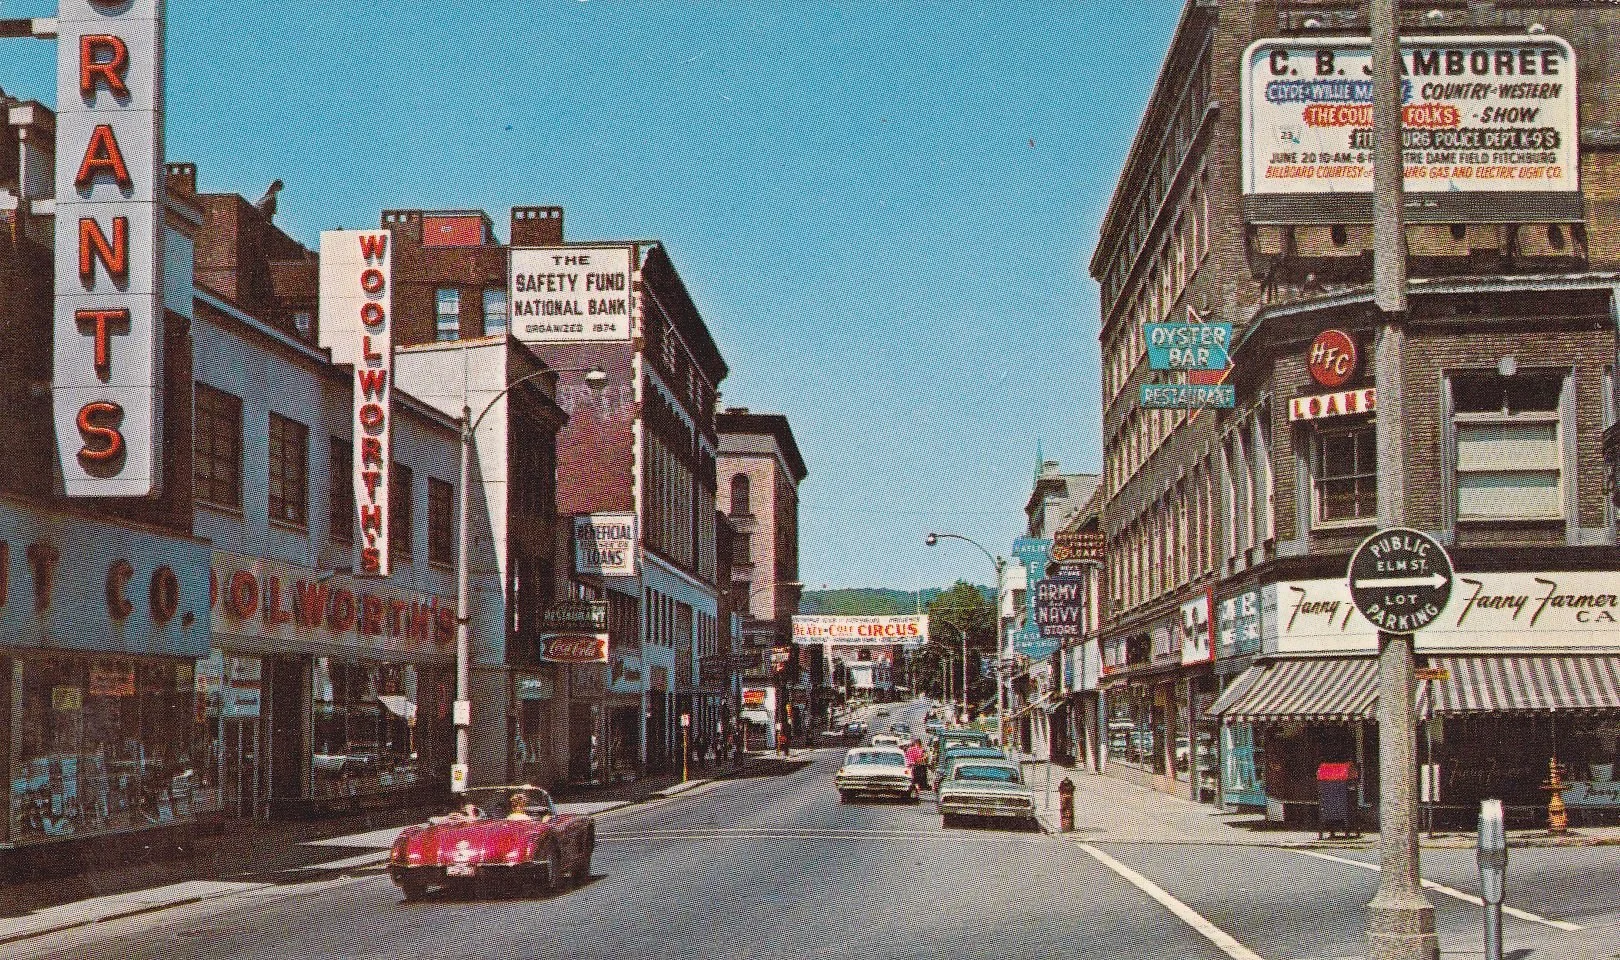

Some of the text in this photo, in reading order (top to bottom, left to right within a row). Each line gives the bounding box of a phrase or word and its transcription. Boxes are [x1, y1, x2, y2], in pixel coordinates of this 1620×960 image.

[1270, 50, 1297, 75] C.
[1316, 50, 1344, 75] B.
[1421, 82, 1490, 100] COUNTRY
[1498, 82, 1562, 100] WESTERN
[1309, 108, 1336, 123] THE
[1407, 107, 1454, 124] FOLKS
[1434, 131, 1481, 147] POLICE
[1269, 152, 1297, 164] JUNE
[1301, 152, 1317, 164] 20
[1426, 152, 1456, 164] DAME
[1459, 152, 1489, 164] FIELD
[1492, 152, 1556, 164] FITCHBURG
[1265, 165, 1314, 179] BILLBOARD
[1316, 165, 1363, 179] COURTESY
[1429, 166, 1449, 179] GAS
[1452, 166, 1473, 179] AND
[1475, 166, 1516, 179] ELECTRIC
[1518, 166, 1544, 179] LIGHT
[74, 0, 129, 463] RANTS
[551, 255, 590, 265] THE
[515, 272, 626, 292] SAFETY FUND
[514, 298, 626, 317] NATIONAL BANK
[525, 324, 583, 333] ORGANIZED
[1151, 326, 1227, 346] OYSTER
[1169, 348, 1210, 367] BAR
[1312, 342, 1349, 375] HFC
[1144, 387, 1233, 405] RESTAURANT
[1293, 389, 1377, 418] LOANS
[577, 525, 633, 540] BENEFICIAL
[1369, 535, 1431, 559] PUBLIC
[587, 551, 624, 566] LOANS
[1377, 560, 1407, 572] ELM
[1038, 583, 1079, 602] ARMY
[1385, 594, 1418, 606] LOT
[1287, 585, 1340, 634] Fanny
[1456, 577, 1618, 628] Fanny Farmer
[1038, 606, 1080, 625] NAVY
[1366, 603, 1438, 630] PARKING
[857, 622, 920, 637] CIRCUS
[1043, 624, 1079, 635] STORE
